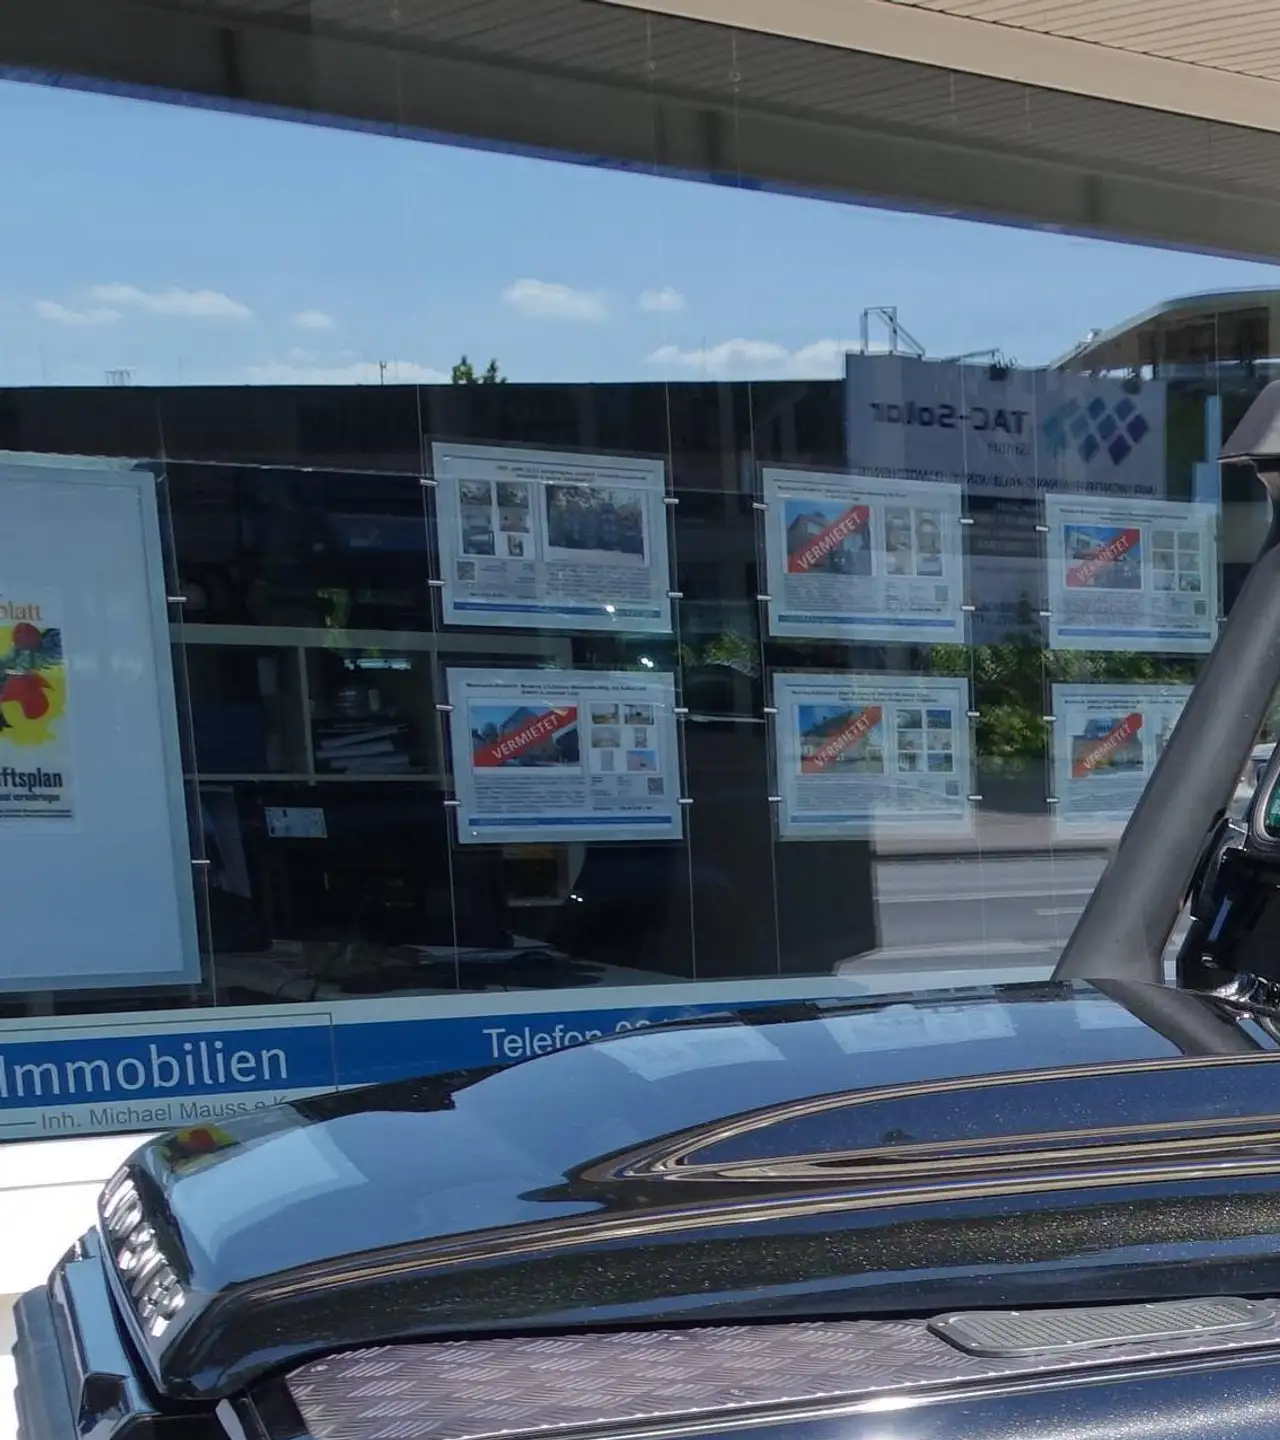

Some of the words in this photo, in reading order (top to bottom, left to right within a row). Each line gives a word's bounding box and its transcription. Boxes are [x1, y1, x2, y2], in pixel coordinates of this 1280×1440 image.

[797, 510, 862, 570] VERMIETET
[491, 714, 559, 759] VERMIETET
[812, 713, 871, 768] VERMIETET
[0, 766, 63, 793] ftsplan
[482, 1021, 603, 1058] Telefon
[0, 1040, 289, 1099] Immobilien
[41, 1112, 81, 1130] Inh.
[90, 1103, 173, 1126] Michael
[180, 1101, 249, 1121] Mauss
